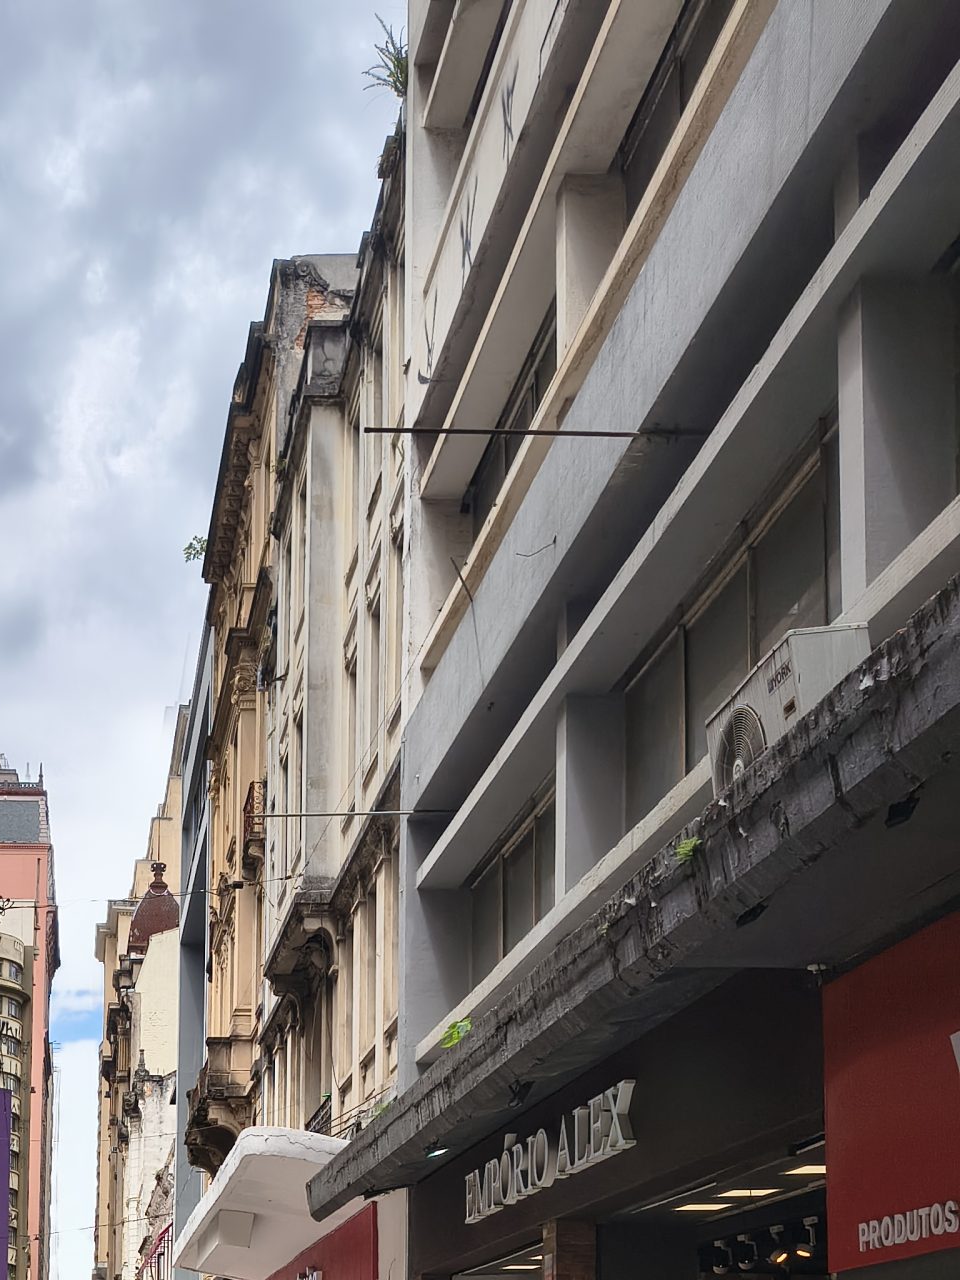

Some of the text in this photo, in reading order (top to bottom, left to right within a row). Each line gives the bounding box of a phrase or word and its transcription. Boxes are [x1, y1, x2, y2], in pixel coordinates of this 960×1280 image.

[772, 661, 791, 687] YORK
[465, 1080, 637, 1224] EMPÓRIO ALEX
[859, 1200, 959, 1252] PRODUTOS
